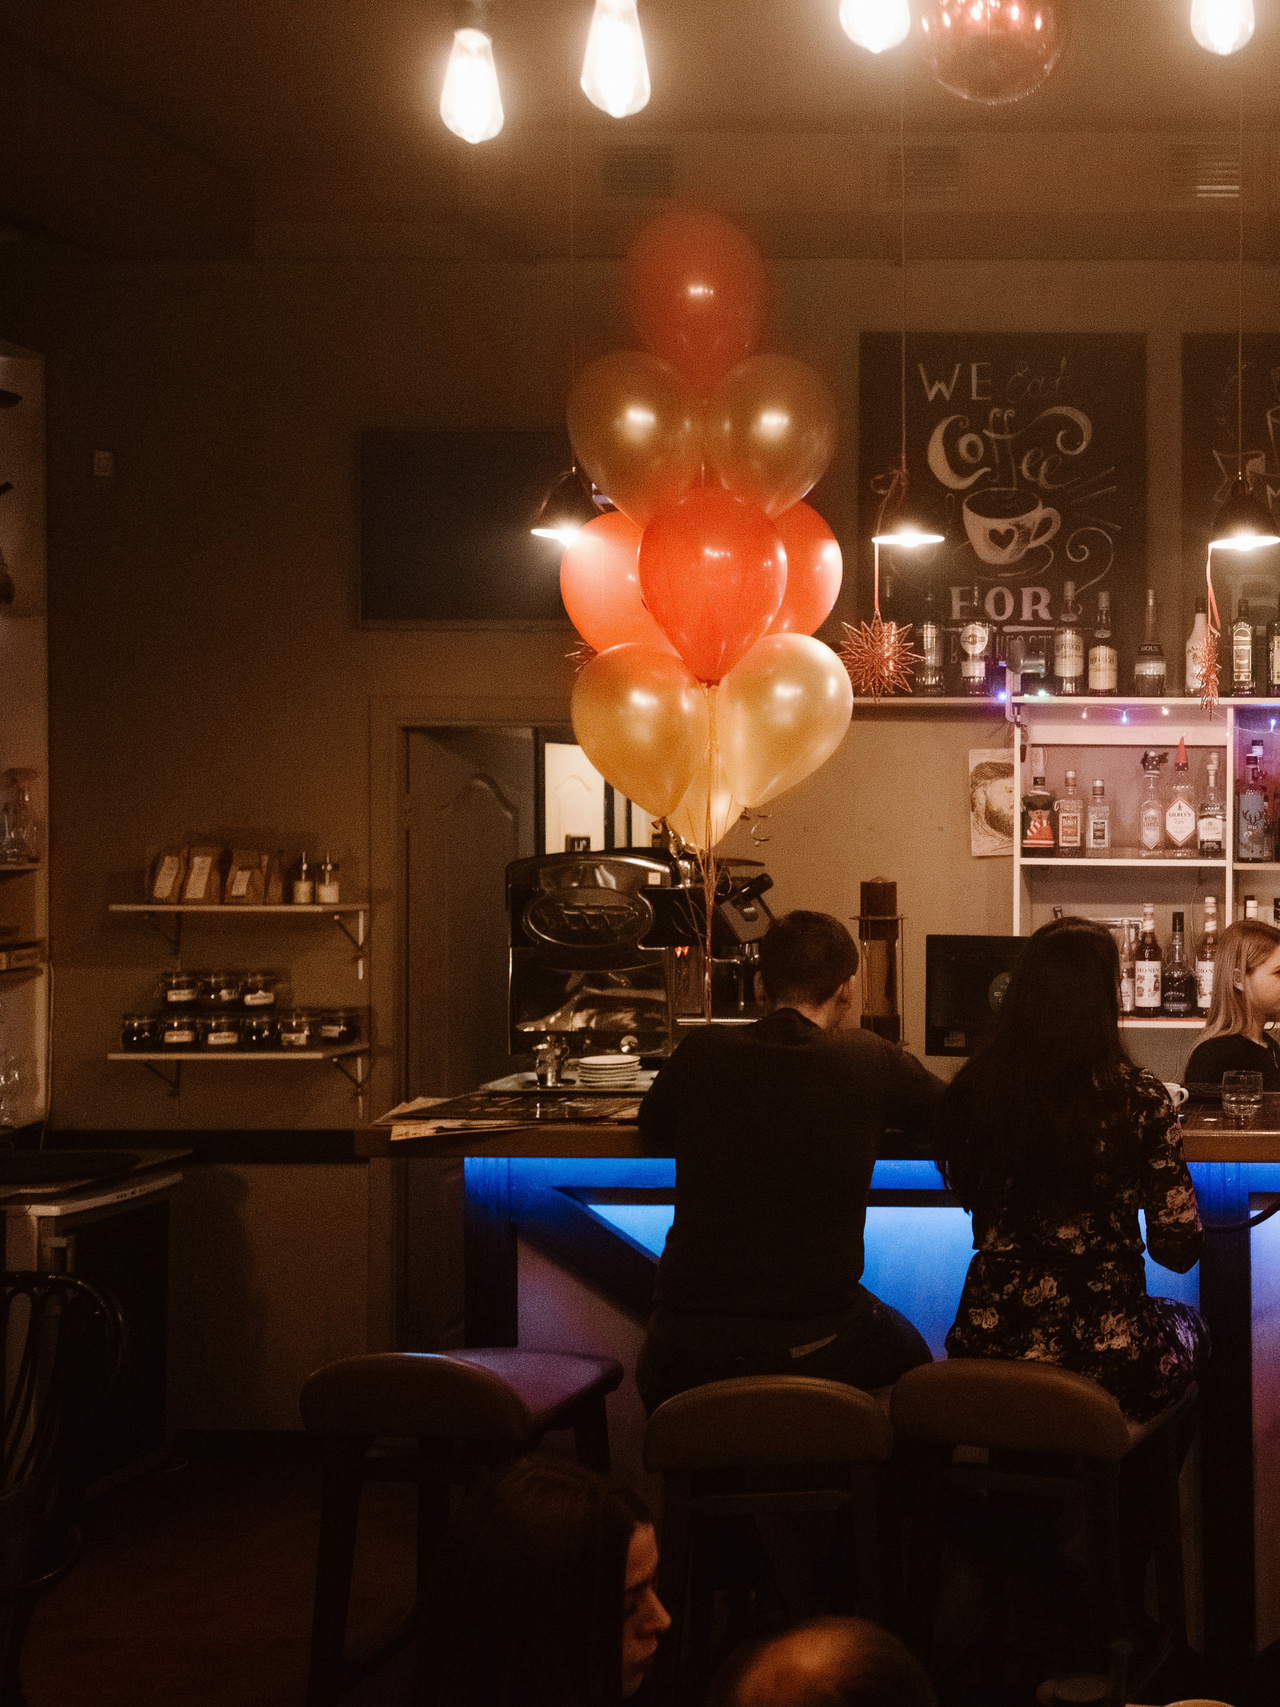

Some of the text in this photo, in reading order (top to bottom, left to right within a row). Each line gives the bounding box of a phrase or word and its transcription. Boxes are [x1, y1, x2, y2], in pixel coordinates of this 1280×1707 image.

[918, 362, 993, 402] WE
[927, 405, 1092, 491] Coffee
[949, 586, 1053, 621] FOR
